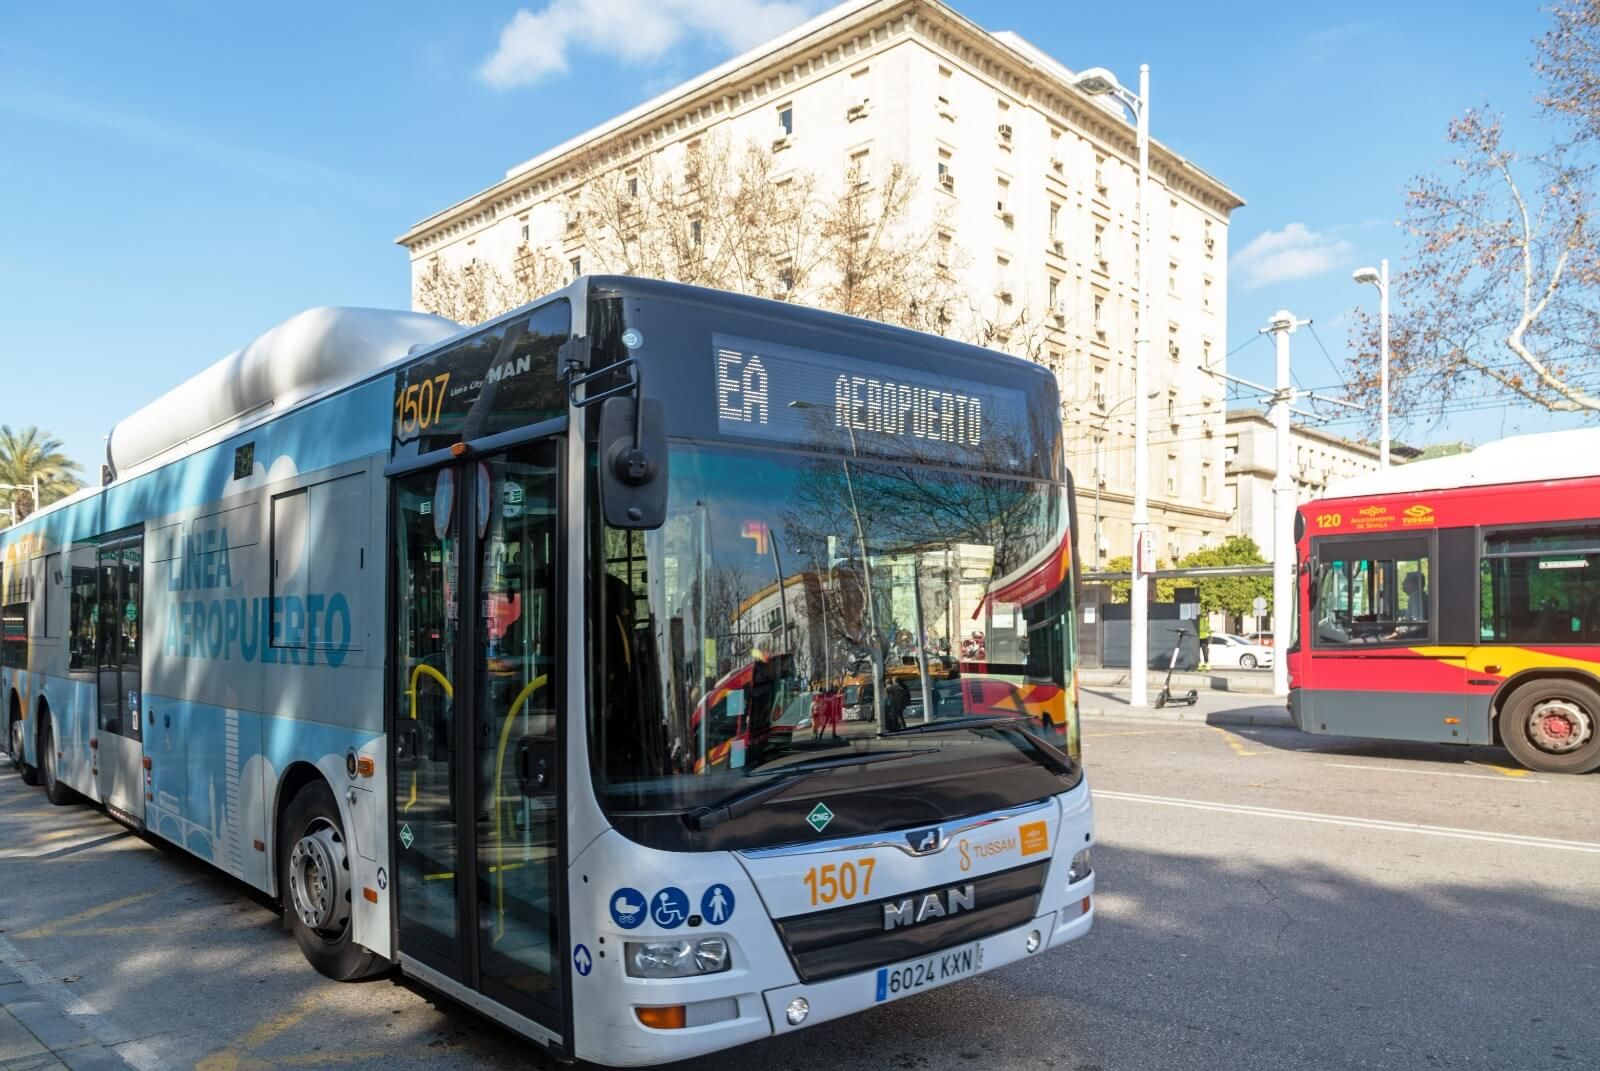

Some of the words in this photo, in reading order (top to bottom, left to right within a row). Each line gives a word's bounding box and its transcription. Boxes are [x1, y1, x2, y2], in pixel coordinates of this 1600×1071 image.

[487, 354, 531, 385] MAN
[395, 372, 450, 433] 1507
[719, 349, 768, 424] EA
[835, 374, 982, 446] AEROPUERTO
[1316, 513, 1341, 528] 120
[164, 592, 351, 668] AEROPUERTO
[973, 836, 1017, 858] TUSSAM
[803, 857, 876, 906] 1507
[883, 885, 975, 931] MAN
[890, 960, 935, 993] 6024
[941, 949, 972, 979] KXN
